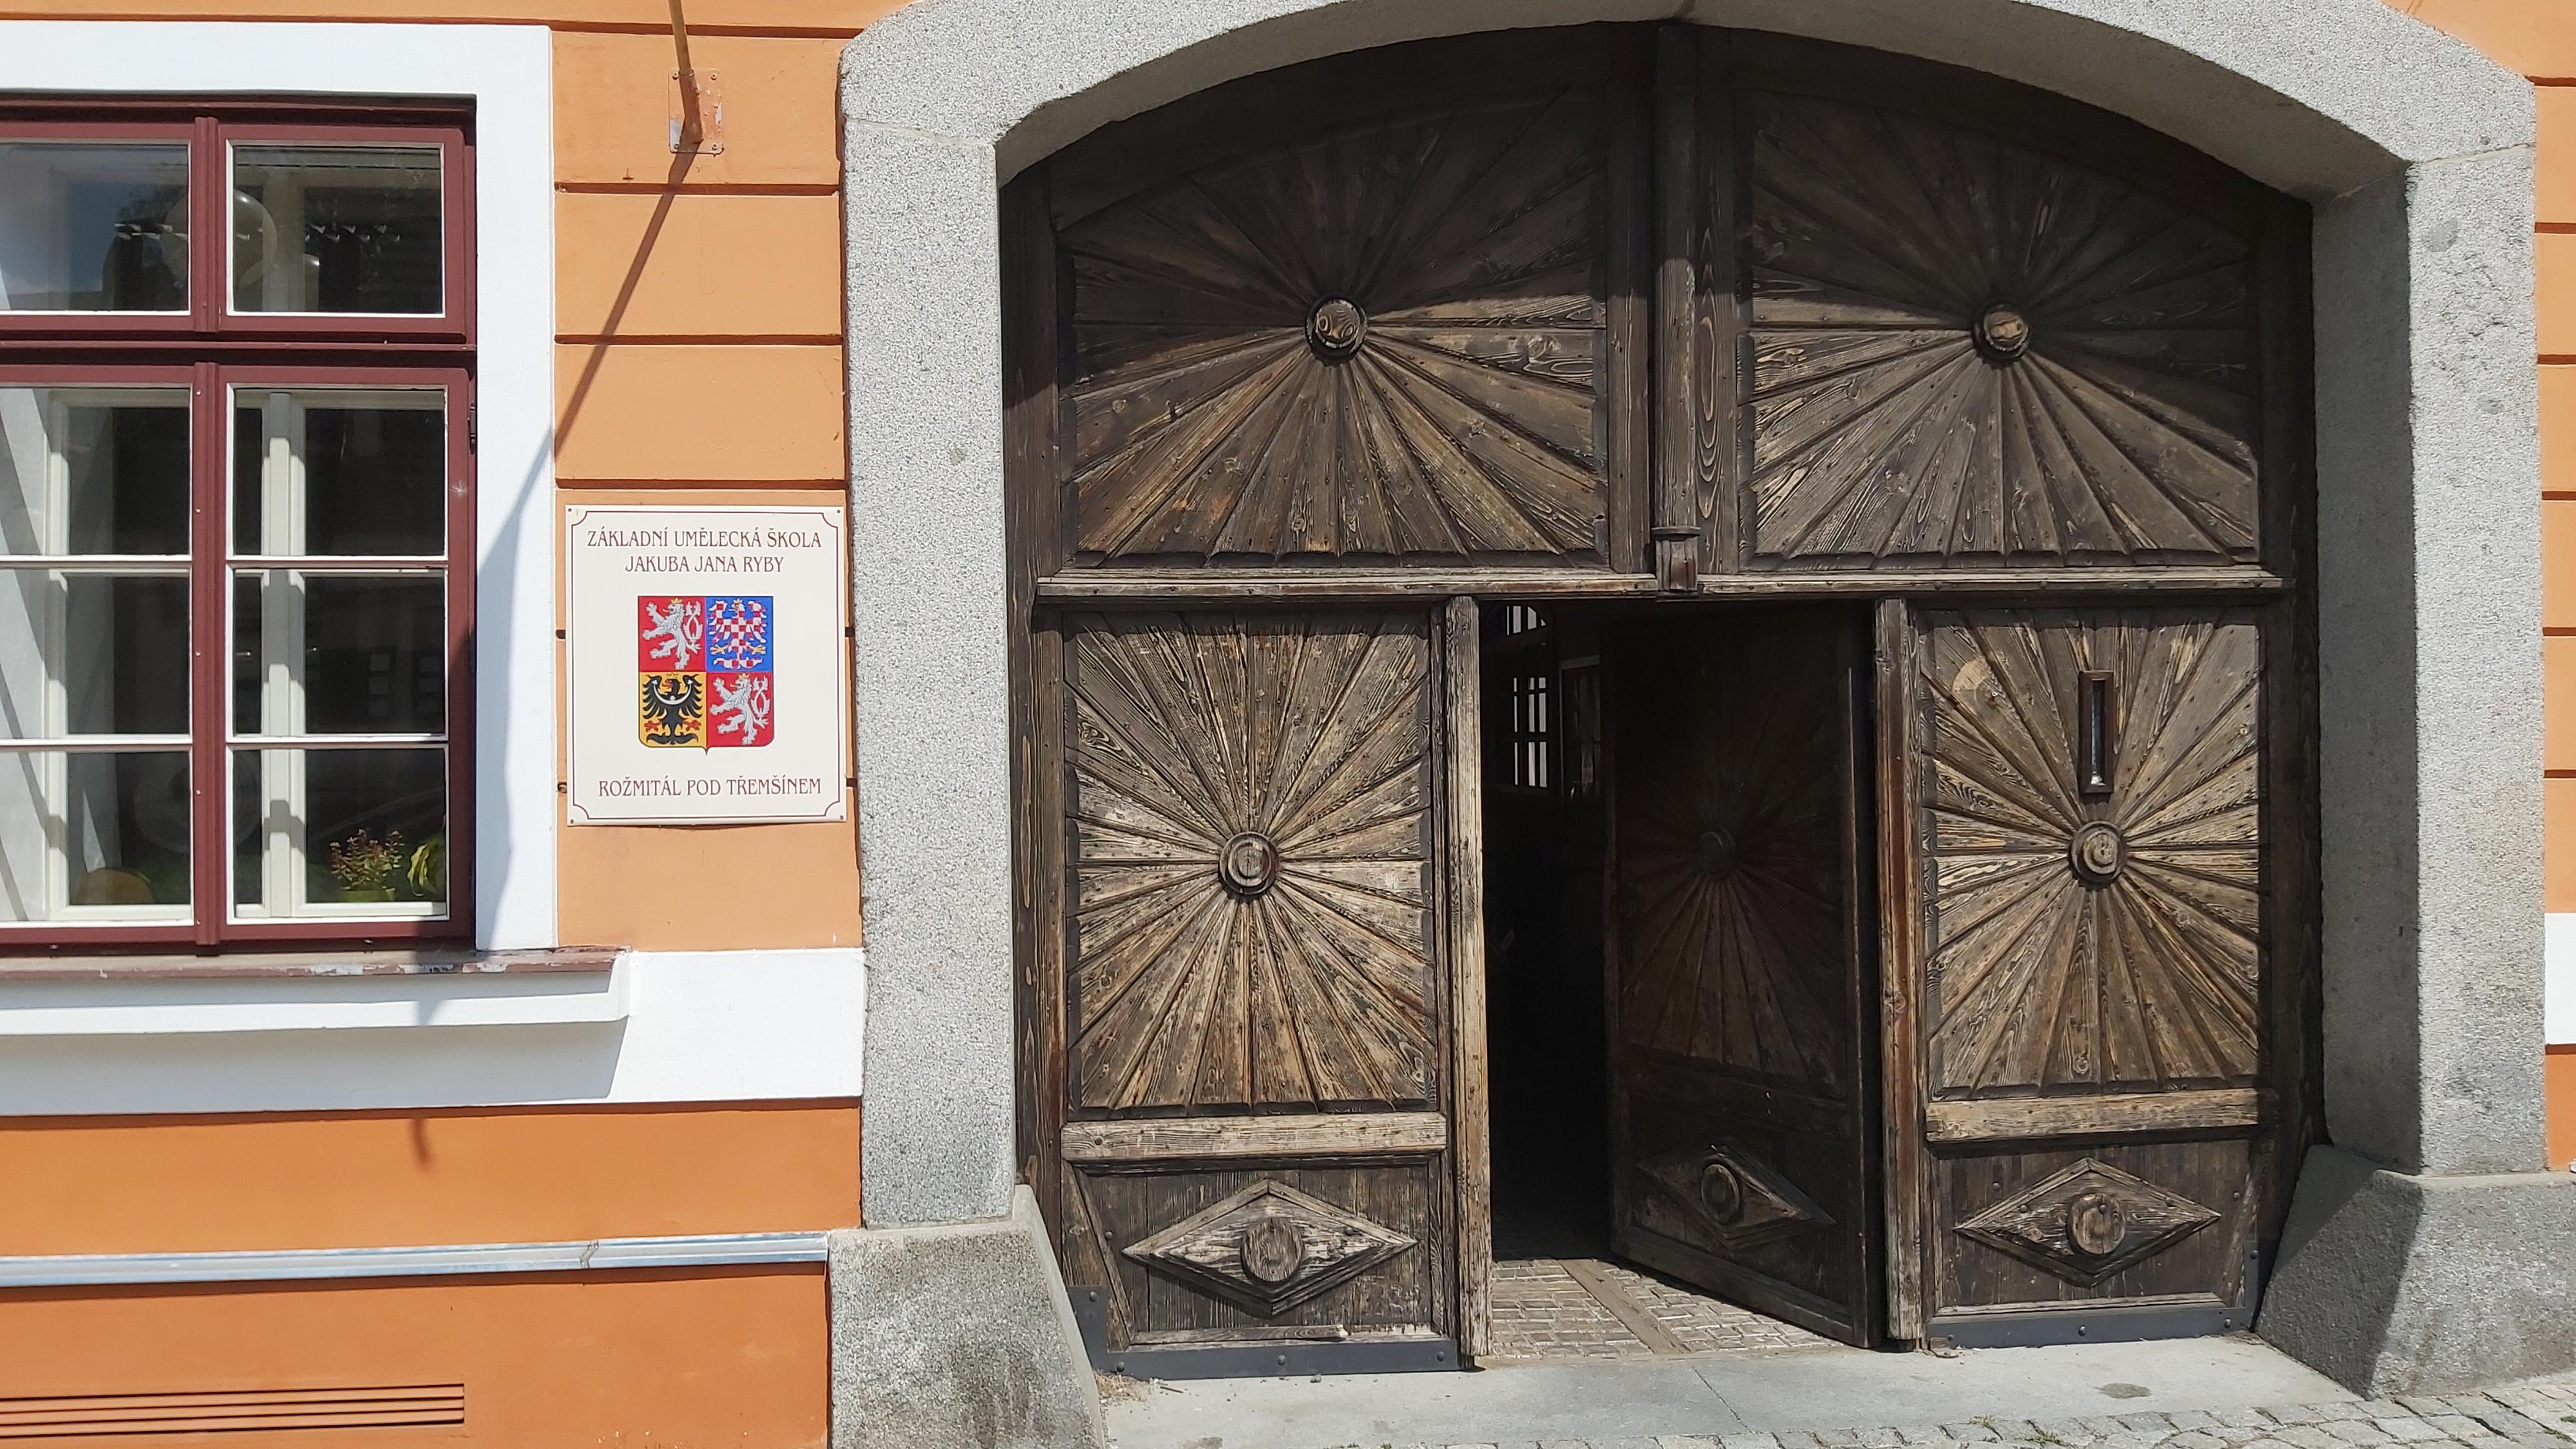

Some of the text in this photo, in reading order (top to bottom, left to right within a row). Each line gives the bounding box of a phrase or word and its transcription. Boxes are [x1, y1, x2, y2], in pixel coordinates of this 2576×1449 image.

[587, 526, 822, 548] ZÁKLADNÍ UMĚLECKÁ ŠKOLA
[625, 556, 784, 573] JAKUBA JANA RYBY
[599, 774, 821, 797] ROŽMITÁL POD TŘEMŠÍNEM
